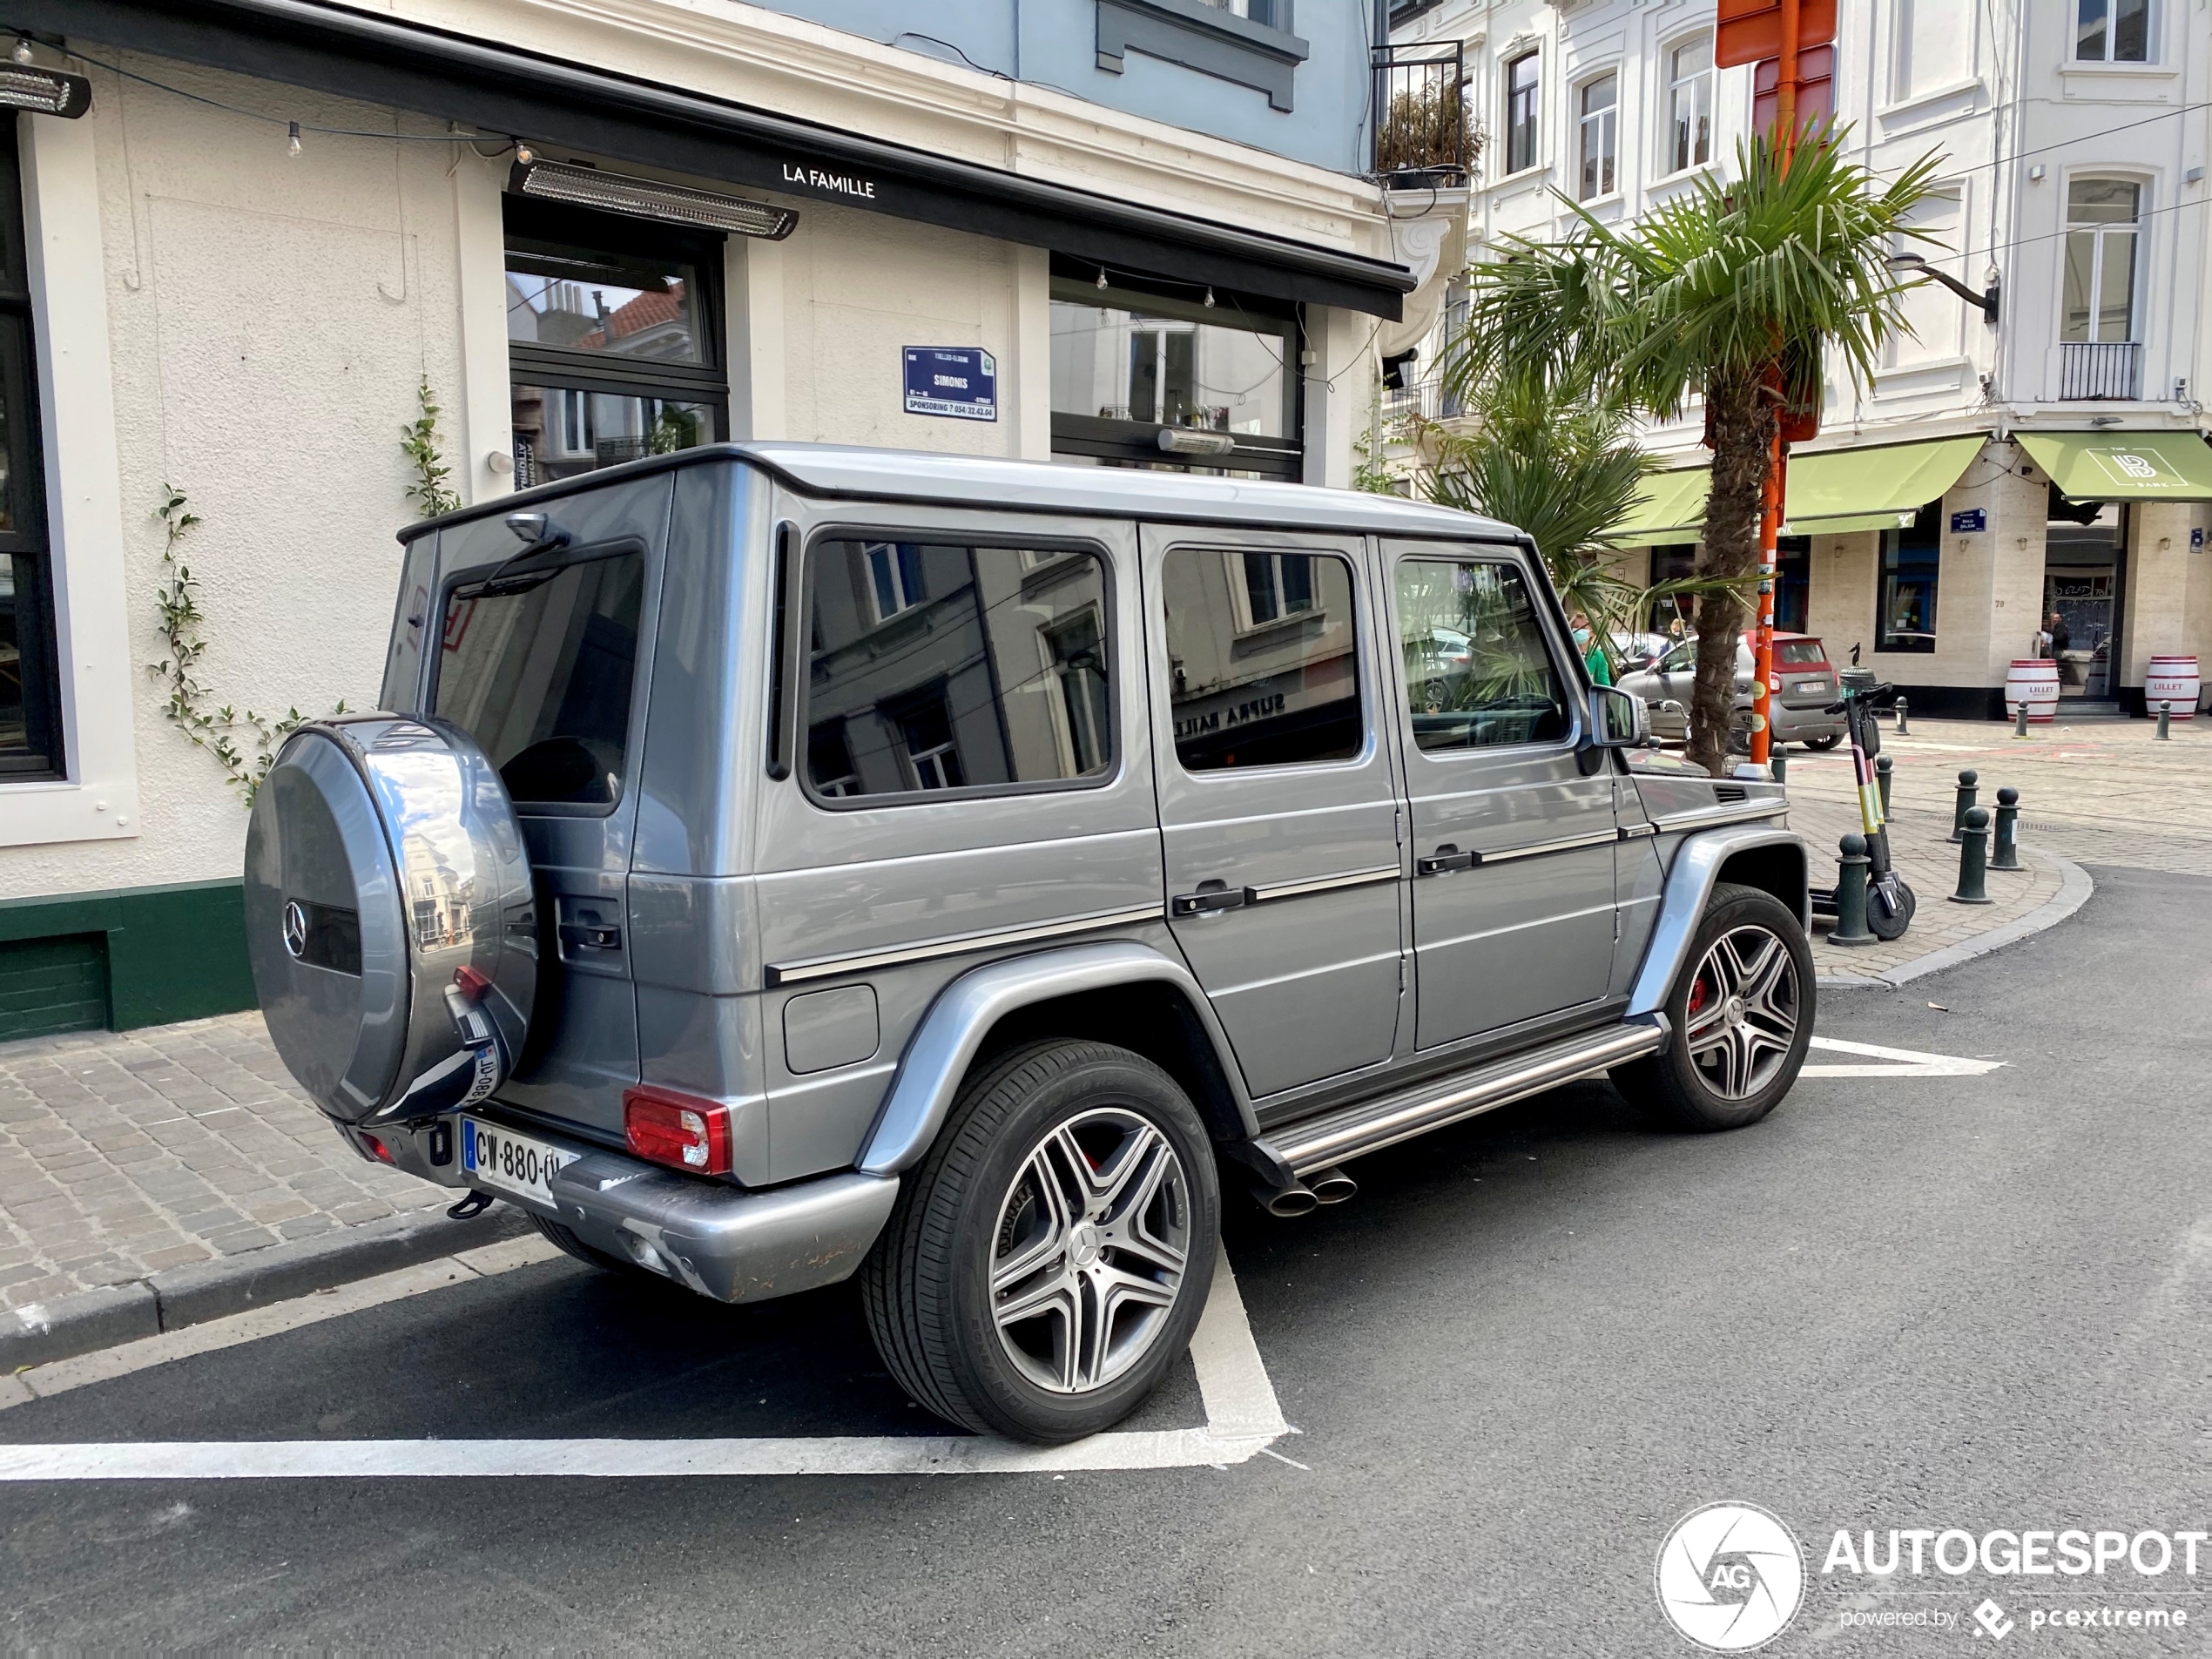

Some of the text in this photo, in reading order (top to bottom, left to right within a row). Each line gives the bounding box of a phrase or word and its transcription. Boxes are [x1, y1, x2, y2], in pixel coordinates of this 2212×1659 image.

[784, 164, 875, 199] LA FAMILLE
[934, 374, 968, 389] SIMONIS
[909, 400, 948, 412] SPONSORING
[954, 405, 993, 416] 054/32.43.04
